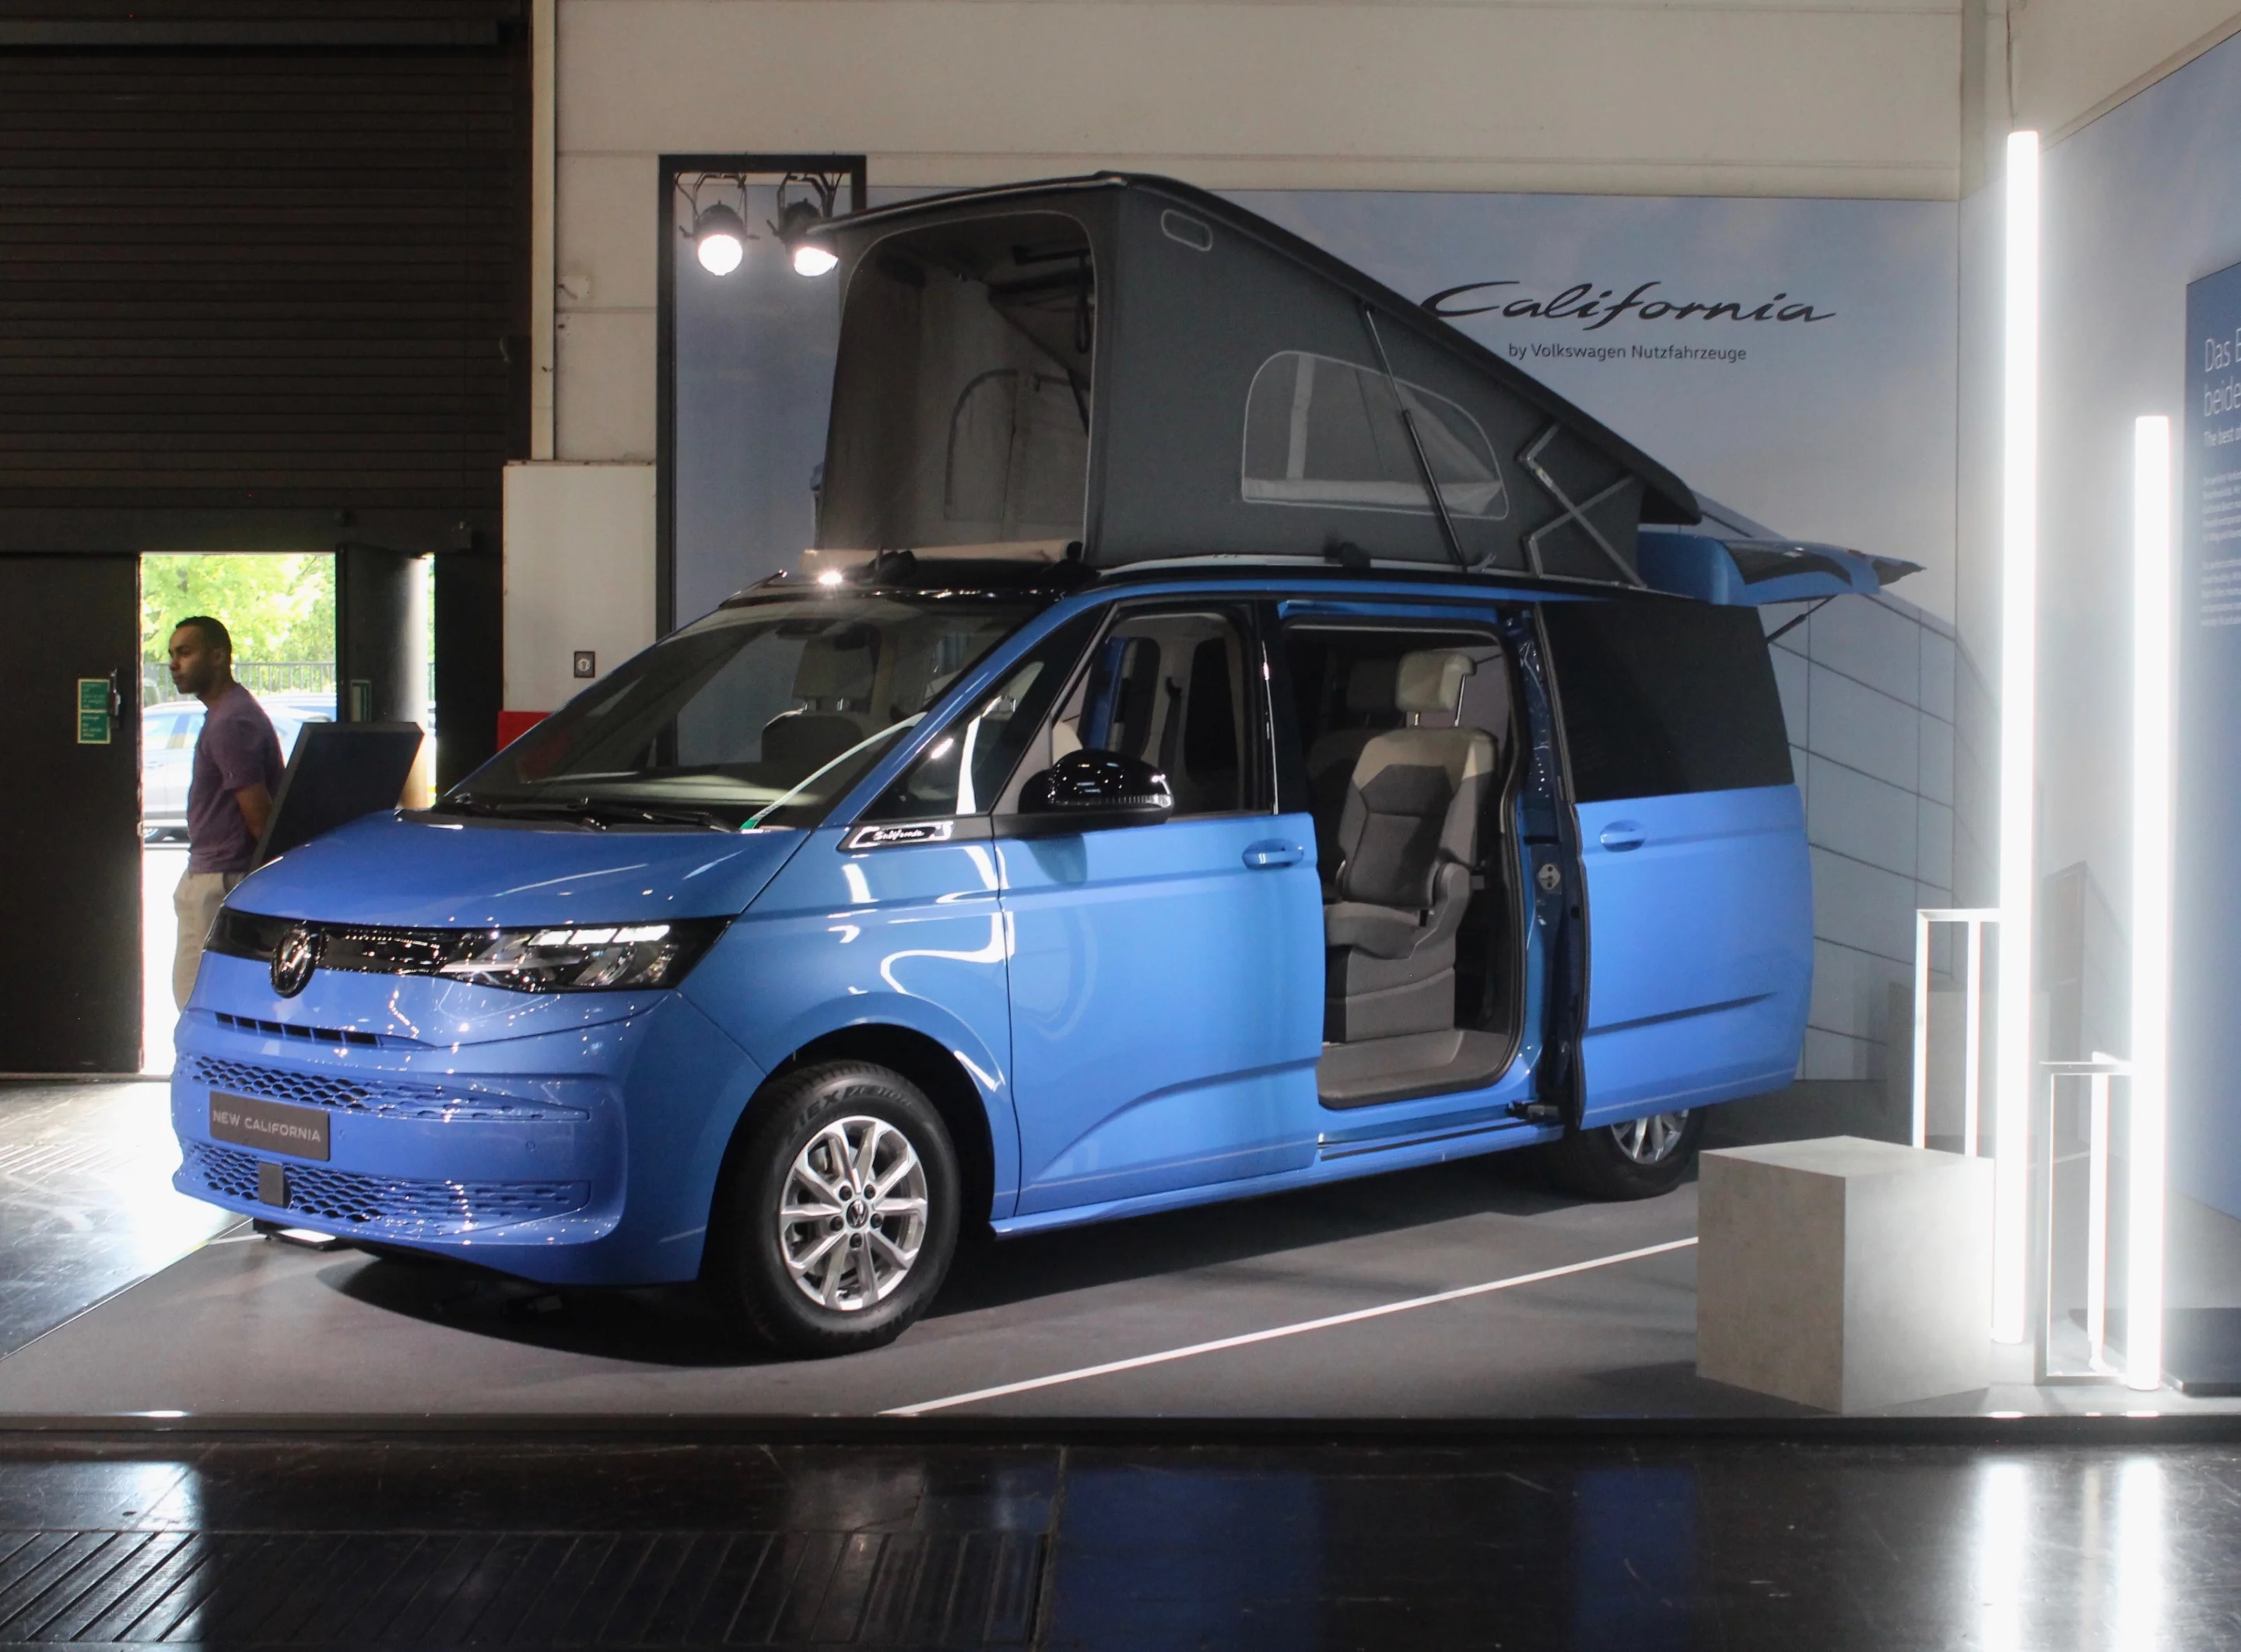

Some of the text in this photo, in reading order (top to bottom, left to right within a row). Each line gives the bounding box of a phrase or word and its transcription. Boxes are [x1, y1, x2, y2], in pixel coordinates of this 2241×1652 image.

[1419, 280, 1836, 331] California
[1509, 342, 1748, 363] by Volkswagen Nutzfahrzeuge
[2205, 338, 2232, 373] Das
[212, 1109, 321, 1142] NEW CALIFORNIA
